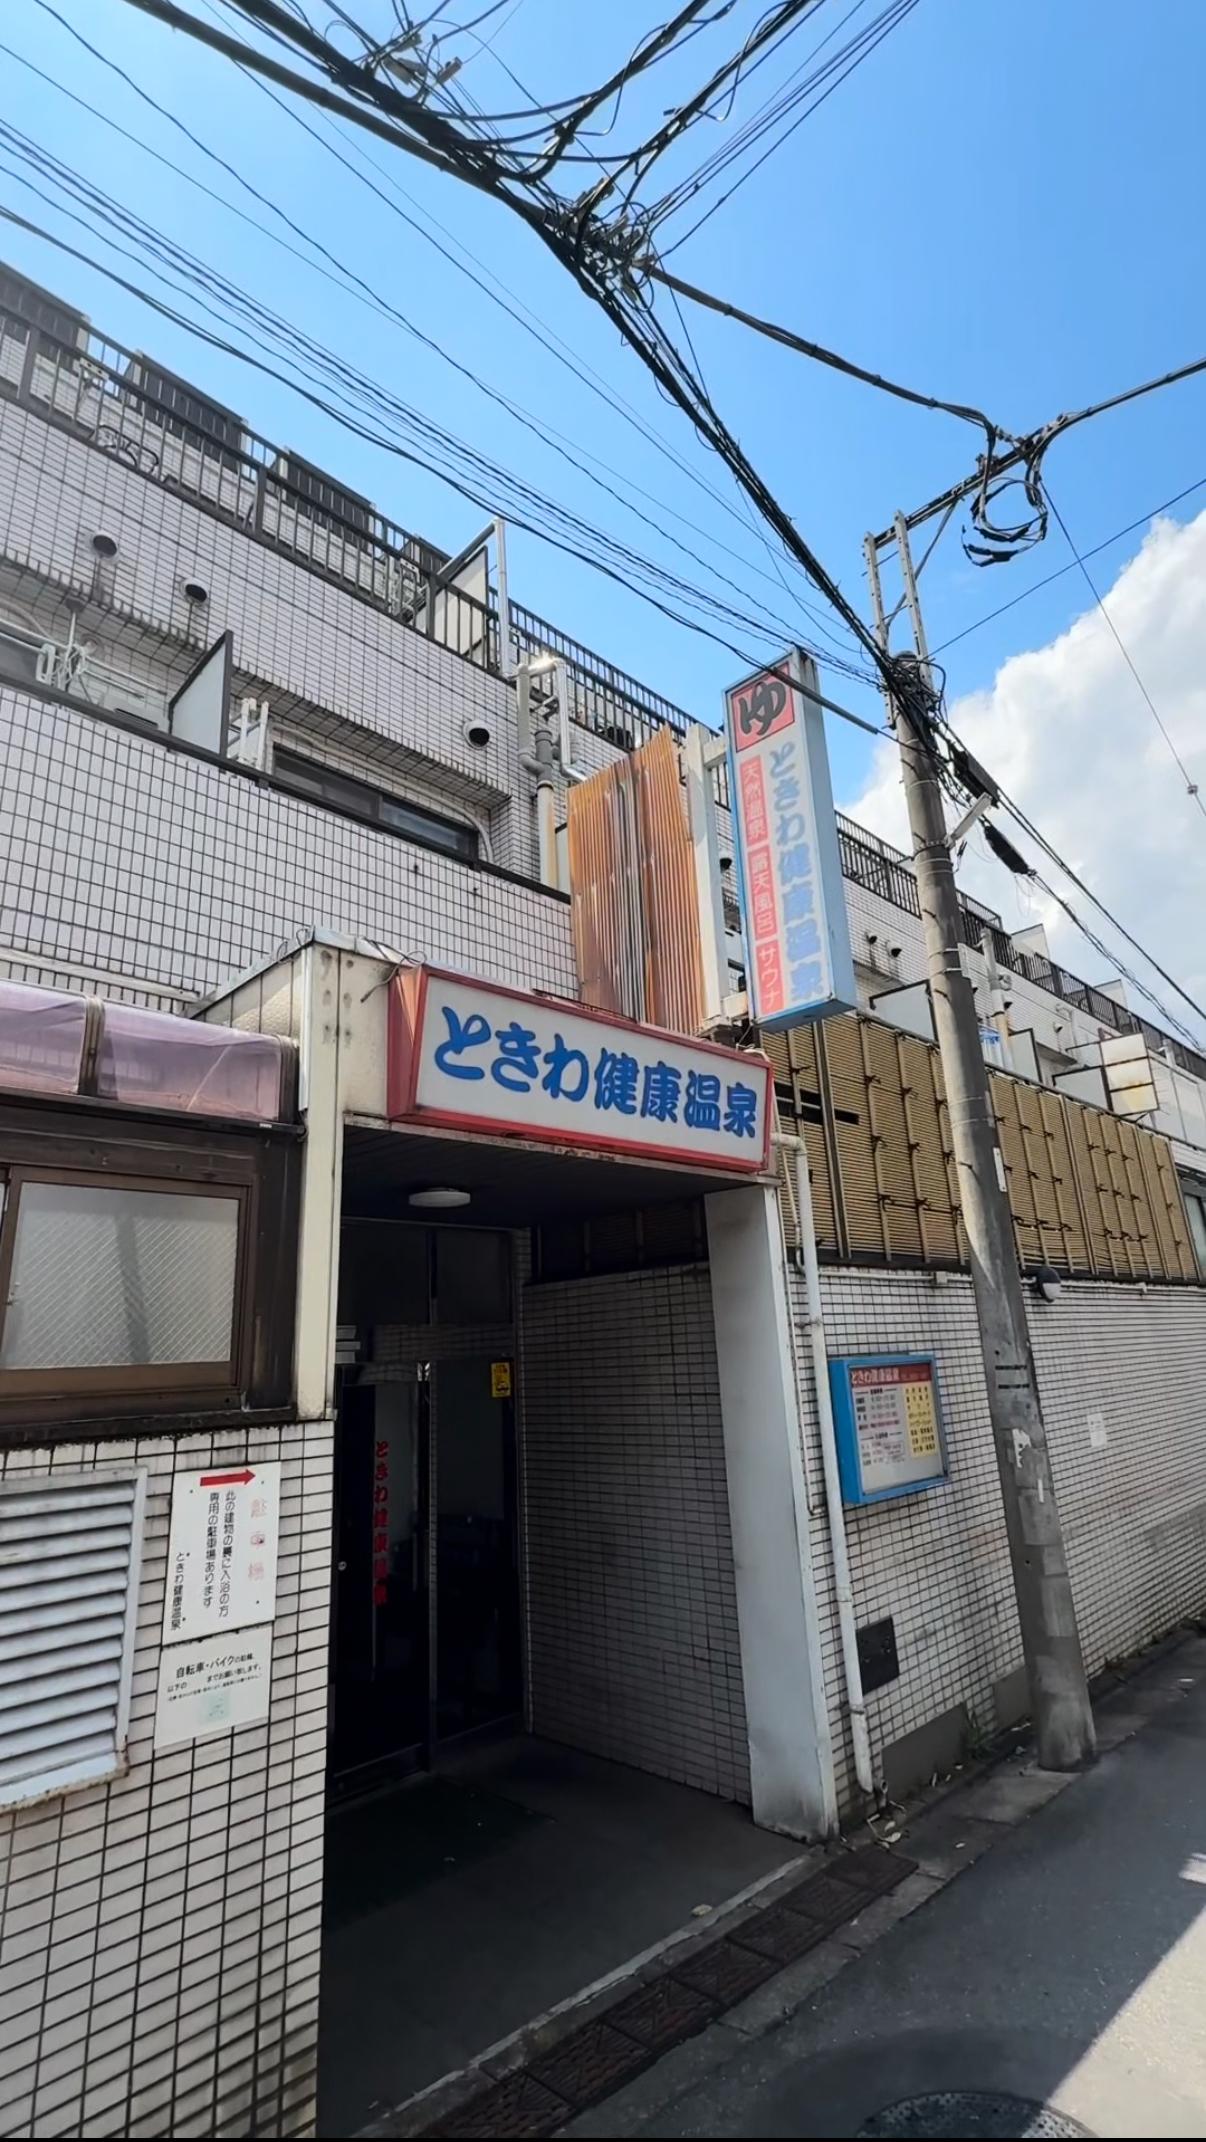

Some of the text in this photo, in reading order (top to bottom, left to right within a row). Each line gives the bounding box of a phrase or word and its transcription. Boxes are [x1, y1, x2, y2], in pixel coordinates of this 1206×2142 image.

[738, 681, 787, 735] ゆ
[759, 946, 781, 1009] サウナ
[434, 1006, 757, 1138] ときわ健康温泉
